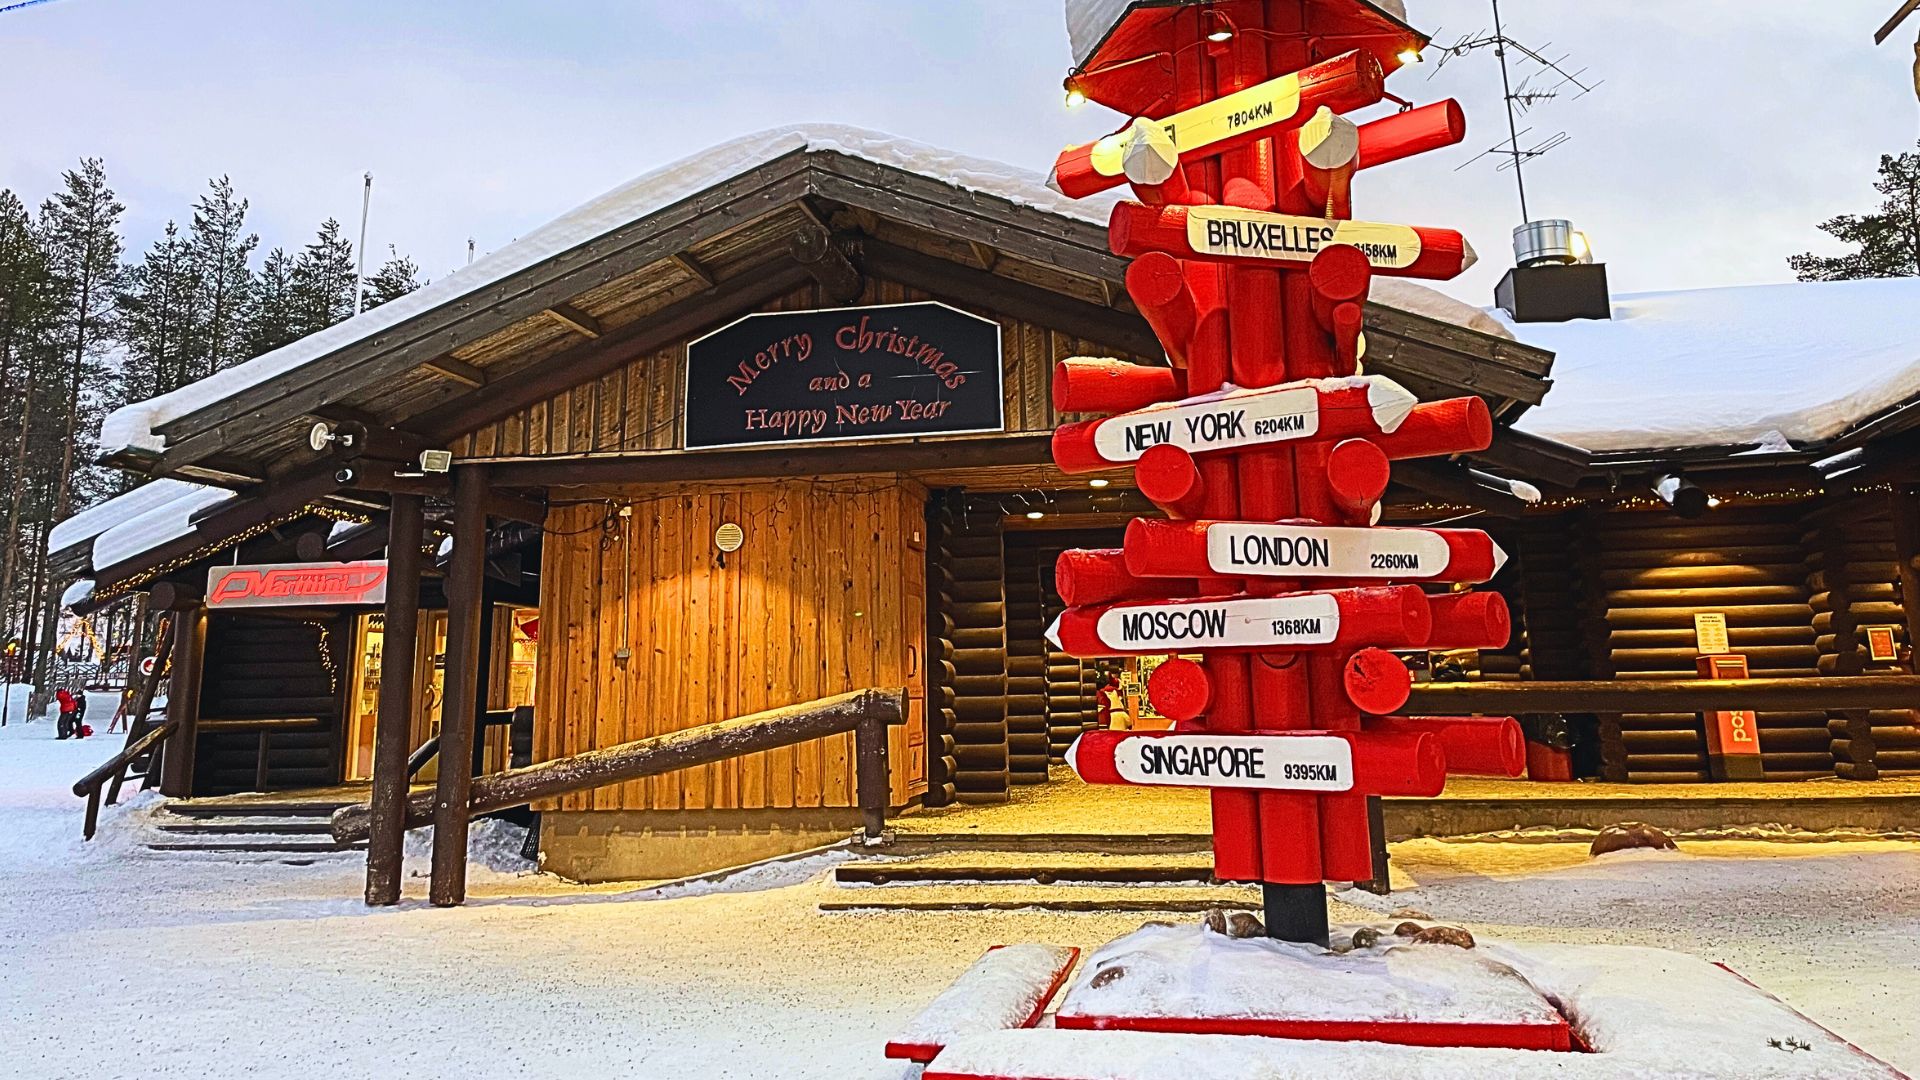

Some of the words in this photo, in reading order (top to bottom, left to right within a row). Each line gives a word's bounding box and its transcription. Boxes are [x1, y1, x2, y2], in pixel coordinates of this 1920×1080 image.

[1227, 101, 1273, 130] 7804KM
[726, 332, 813, 396] Merry
[835, 315, 967, 390] Christmas
[809, 370, 850, 392] and
[858, 372, 873, 389] a
[745, 407, 828, 436] Happy
[836, 402, 893, 425] New
[895, 399, 952, 421] Year
[1125, 420, 1172, 453] NEW
[1185, 410, 1247, 444] YORK
[1254, 414, 1305, 436] 6204KM
[1230, 534, 1330, 568] LONDON
[1370, 553, 1419, 570] 2260KM
[1122, 608, 1227, 642] MOSCOW
[1271, 618, 1321, 636] 1368KM
[1140, 744, 1266, 779] SINGAPORE
[1284, 763, 1337, 782] 9395KM
